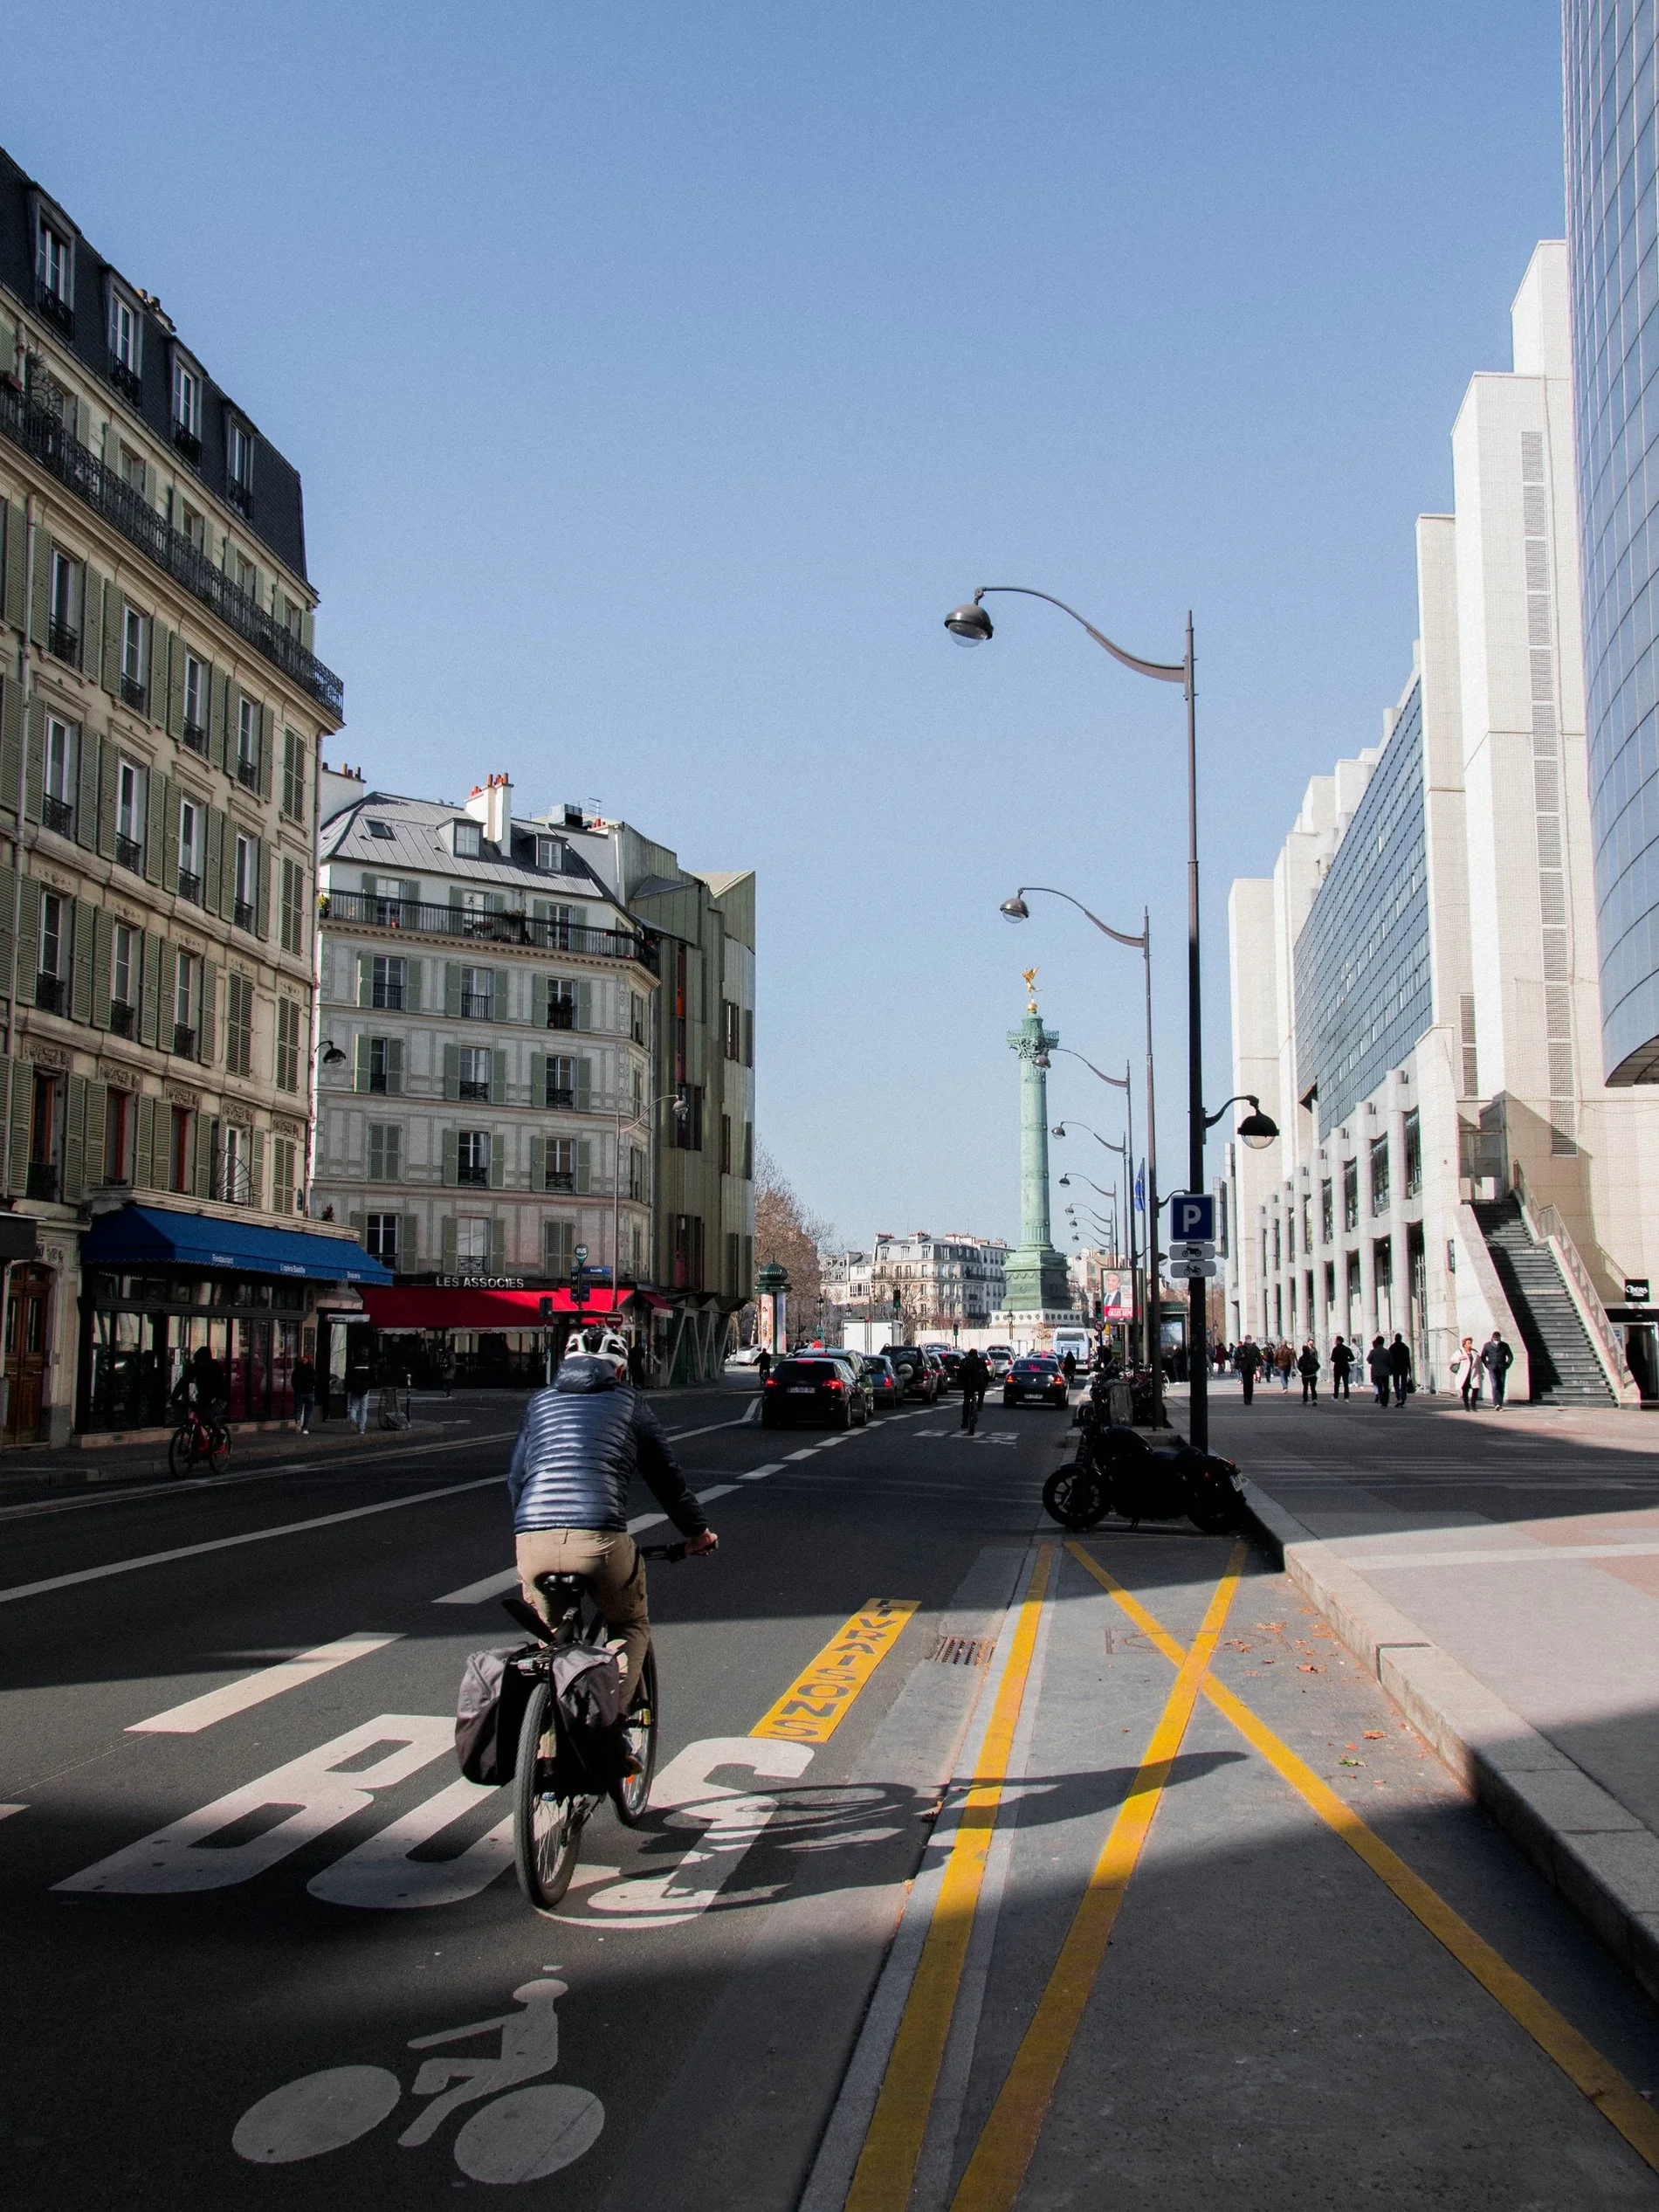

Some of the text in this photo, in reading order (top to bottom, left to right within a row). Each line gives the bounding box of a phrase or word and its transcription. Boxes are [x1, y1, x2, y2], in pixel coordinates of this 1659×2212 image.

[1182, 1204, 1202, 1233] P
[436, 1275, 459, 1286] LES
[764, 1599, 905, 1739] LIVRAISONS
[49, 1713, 815, 1929] BUS
